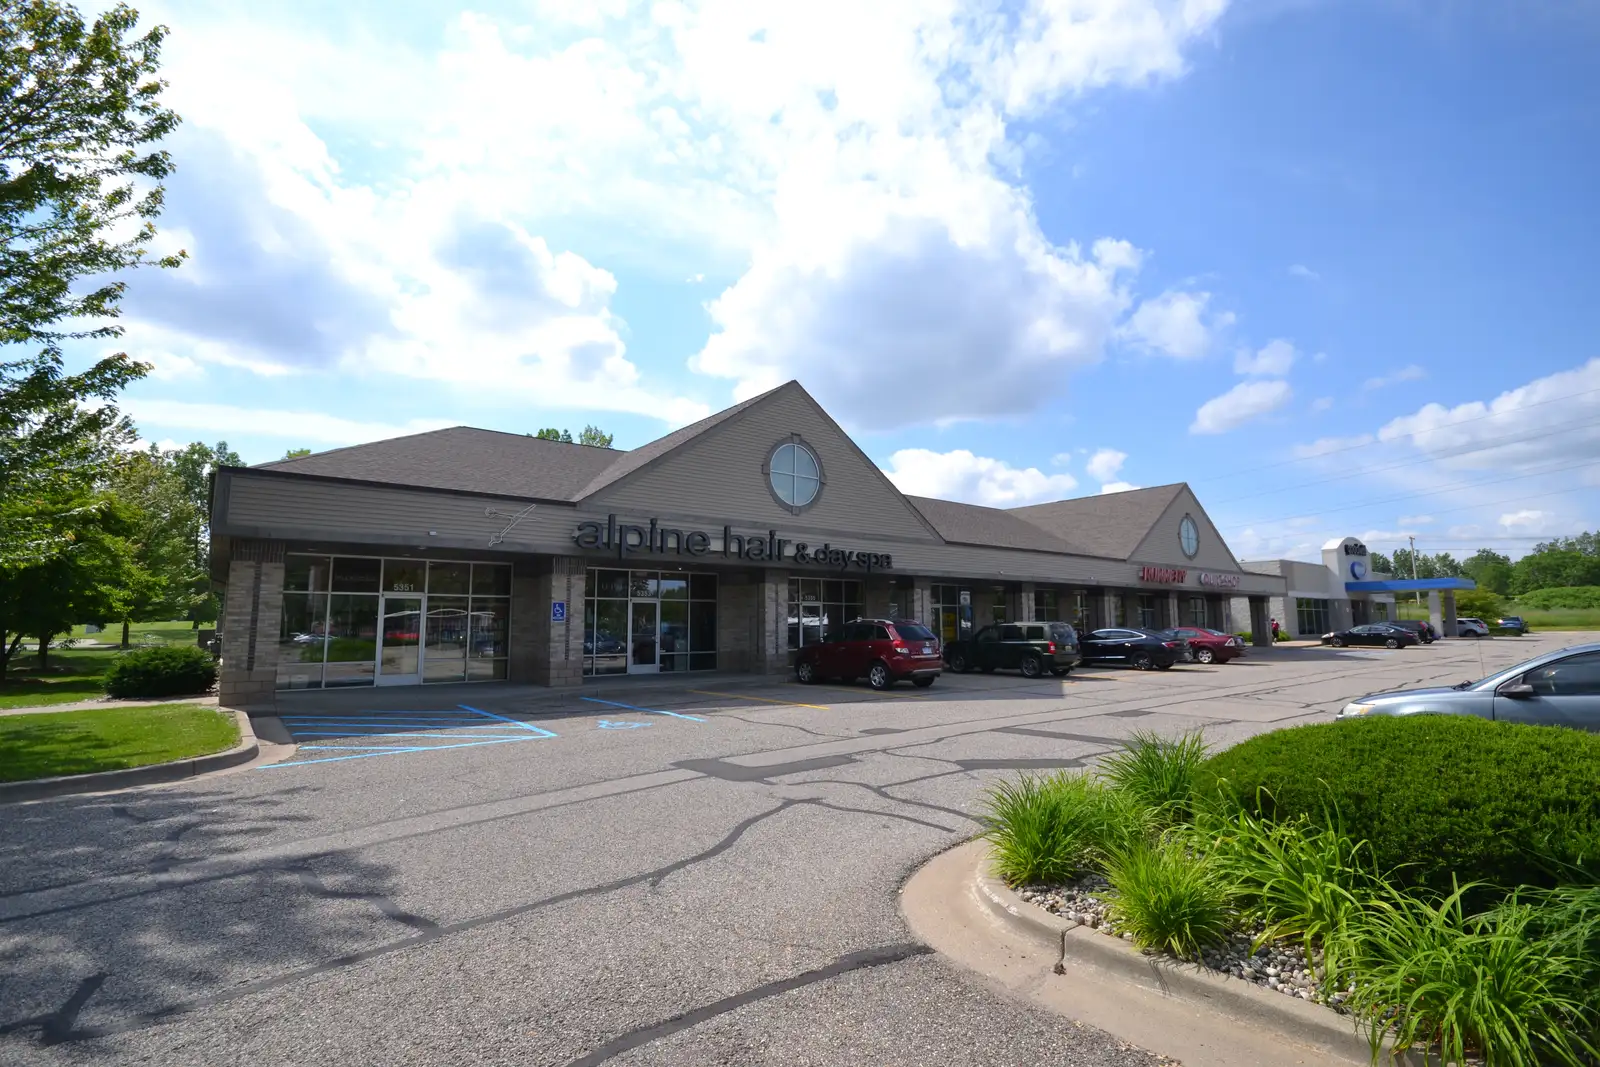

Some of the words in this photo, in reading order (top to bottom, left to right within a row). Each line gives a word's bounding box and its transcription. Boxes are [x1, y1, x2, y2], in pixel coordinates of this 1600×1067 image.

[576, 513, 711, 560] alpine
[723, 525, 792, 562] hair
[794, 542, 811, 564] &
[814, 543, 854, 572] day
[856, 551, 893, 573] spa
[393, 583, 414, 591] 5351
